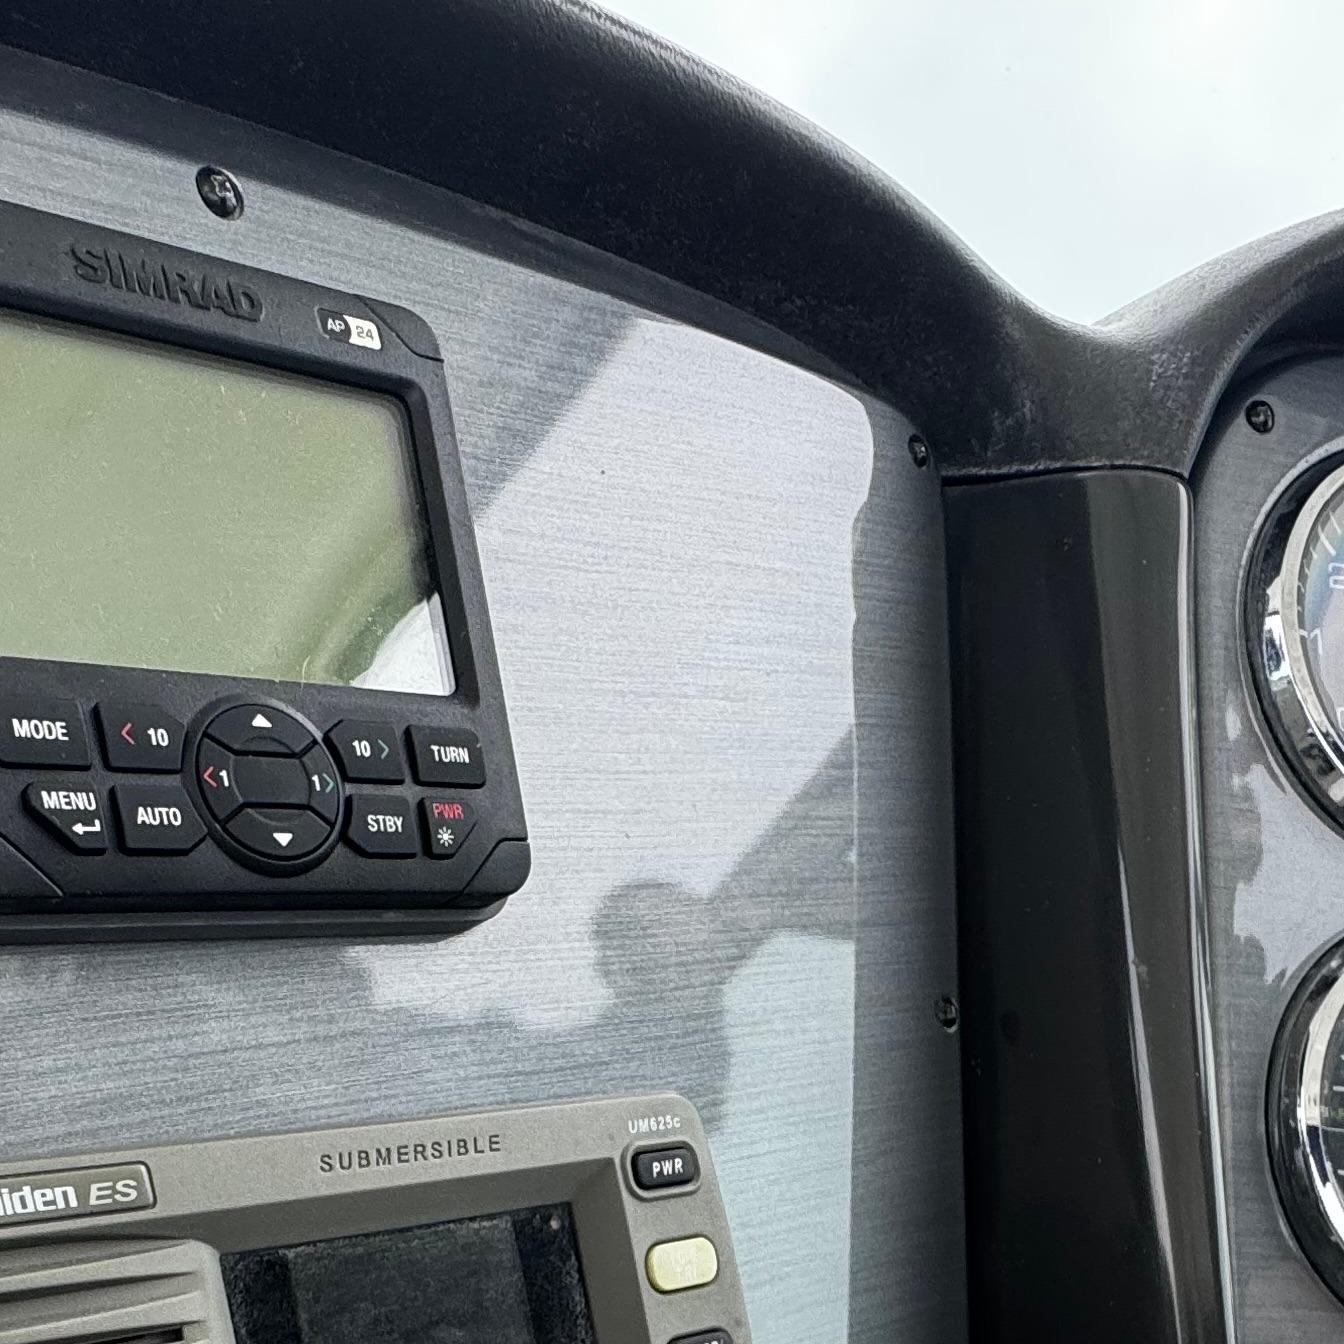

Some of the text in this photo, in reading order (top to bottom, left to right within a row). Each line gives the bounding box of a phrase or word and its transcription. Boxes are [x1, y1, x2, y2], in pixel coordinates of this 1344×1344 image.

[69, 246, 265, 323] SIMRAD
[327, 317, 374, 342] AP 24
[1309, 627, 1324, 656] 1
[12, 717, 69, 742] MODE
[147, 727, 169, 747] 10
[352, 739, 371, 758] 10
[431, 744, 470, 764] TURN
[219, 769, 230, 788] 1
[311, 774, 321, 791] 1
[41, 789, 97, 812] MENU
[432, 802, 465, 820] PWR
[136, 806, 182, 827] AUTO
[367, 813, 404, 833] STBY
[319, 1133, 502, 1174] SUBMERSIBLE
[652, 1157, 684, 1179] PWR
[89, 1178, 138, 1206] ES
